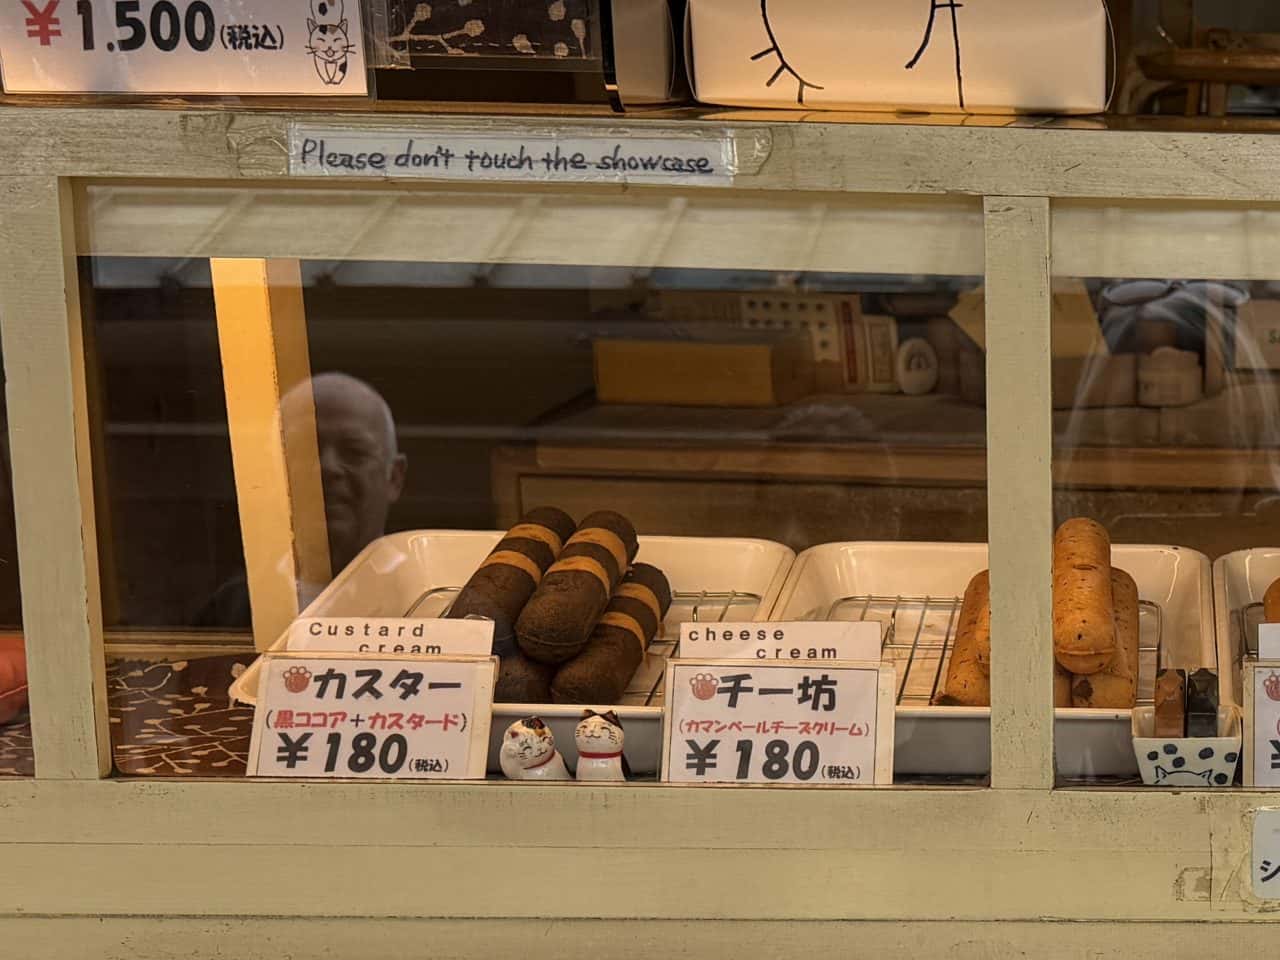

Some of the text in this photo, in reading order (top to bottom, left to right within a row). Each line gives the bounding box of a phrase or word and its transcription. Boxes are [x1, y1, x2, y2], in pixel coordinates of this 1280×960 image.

[219, 24, 285, 51] (税込)
[301, 138, 714, 173] Please don't touch the showcase
[309, 622, 424, 637] Custard
[688, 627, 785, 641] cheese
[359, 643, 442, 654] cream
[756, 647, 837, 659] cream
[313, 668, 461, 700] カスター
[717, 673, 838, 711] チー坊
